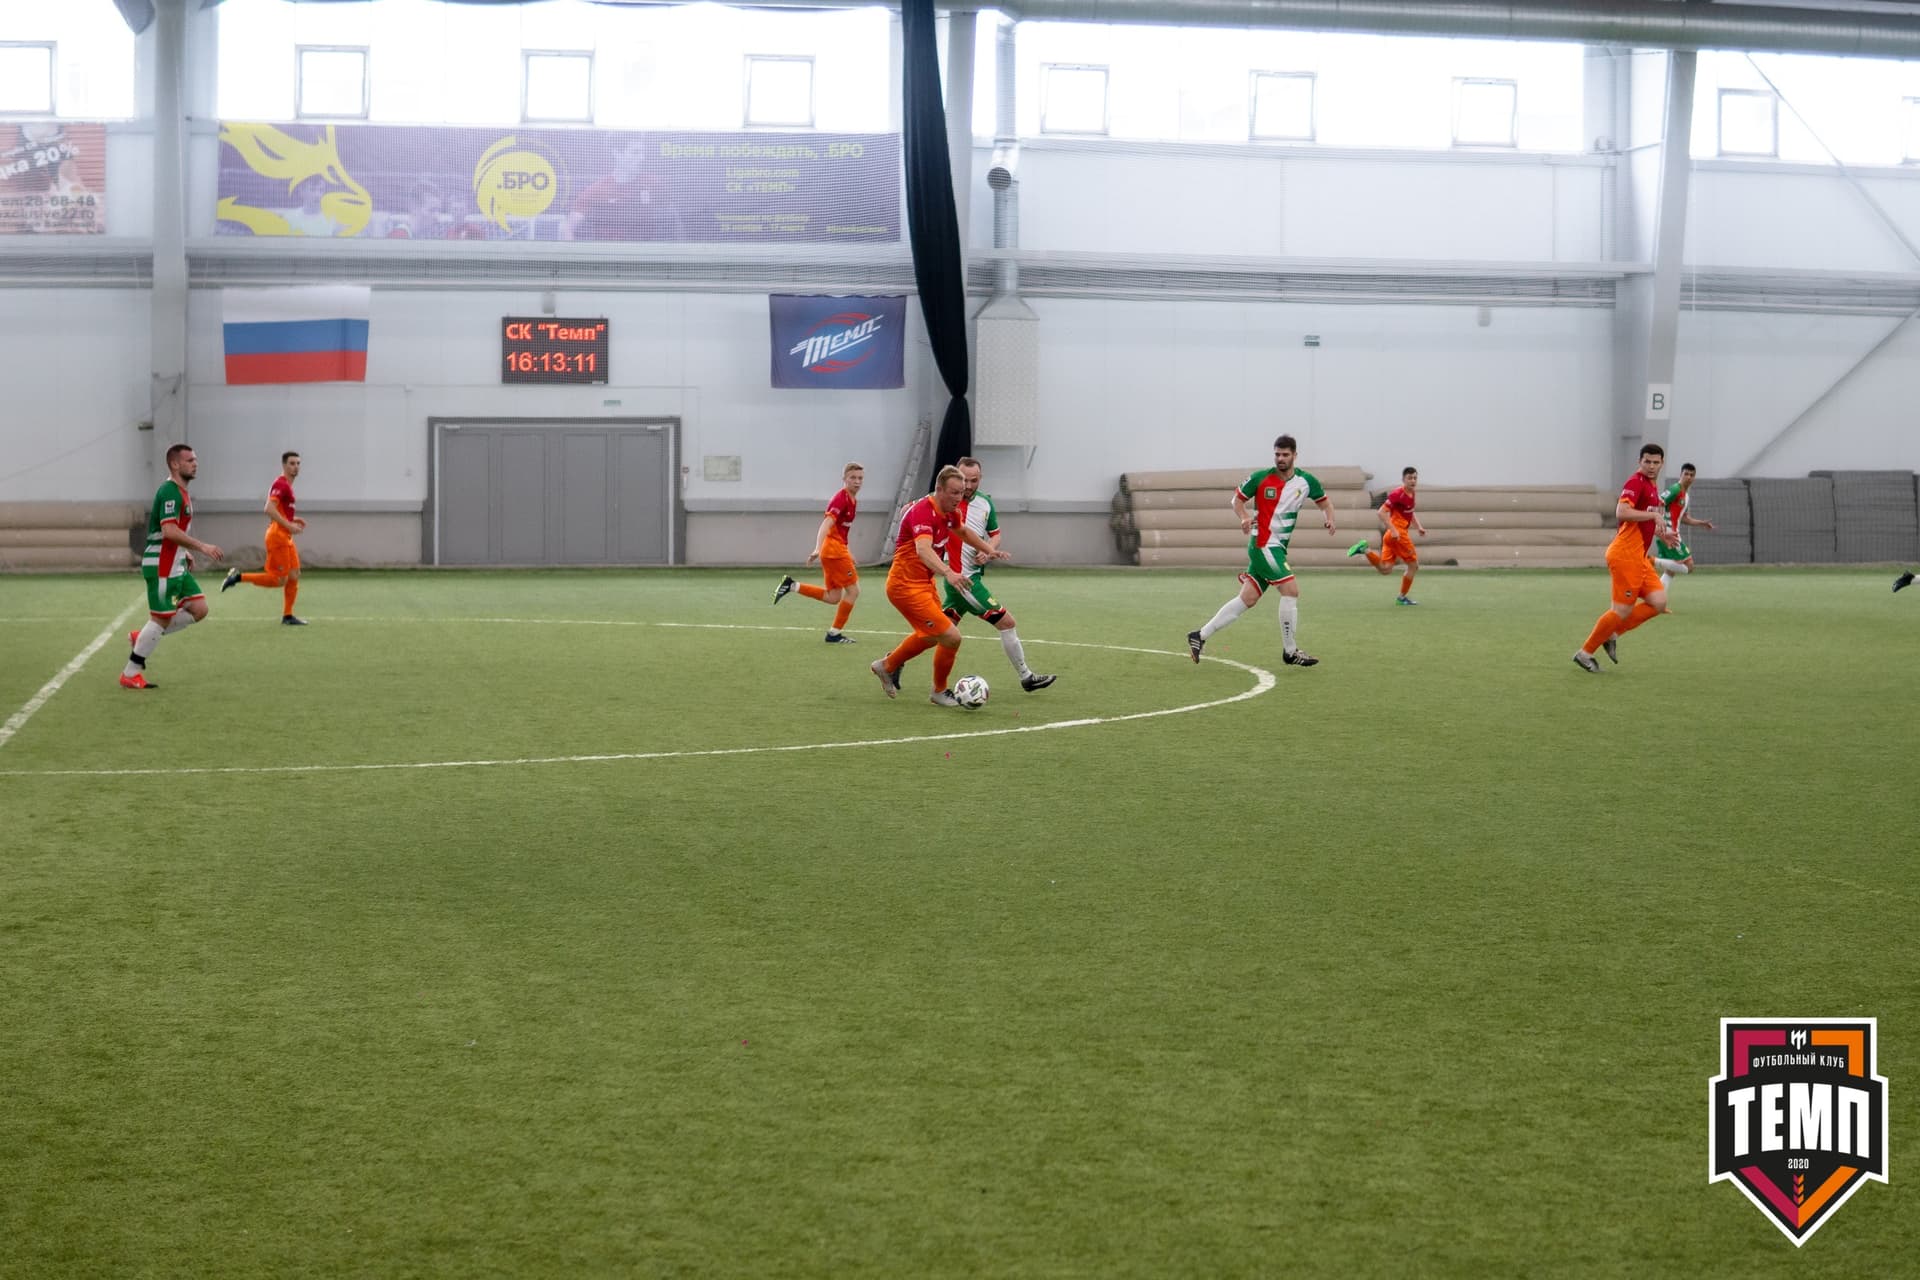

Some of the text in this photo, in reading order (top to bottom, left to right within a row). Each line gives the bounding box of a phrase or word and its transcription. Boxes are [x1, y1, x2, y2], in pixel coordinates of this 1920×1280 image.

[33, 141, 80, 168] 20%
[660, 143, 715, 159] Время
[720, 143, 818, 160] побеждать,
[497, 171, 550, 190] .БРО
[506, 323, 532, 340] СК
[507, 352, 596, 372] 16:13:11
